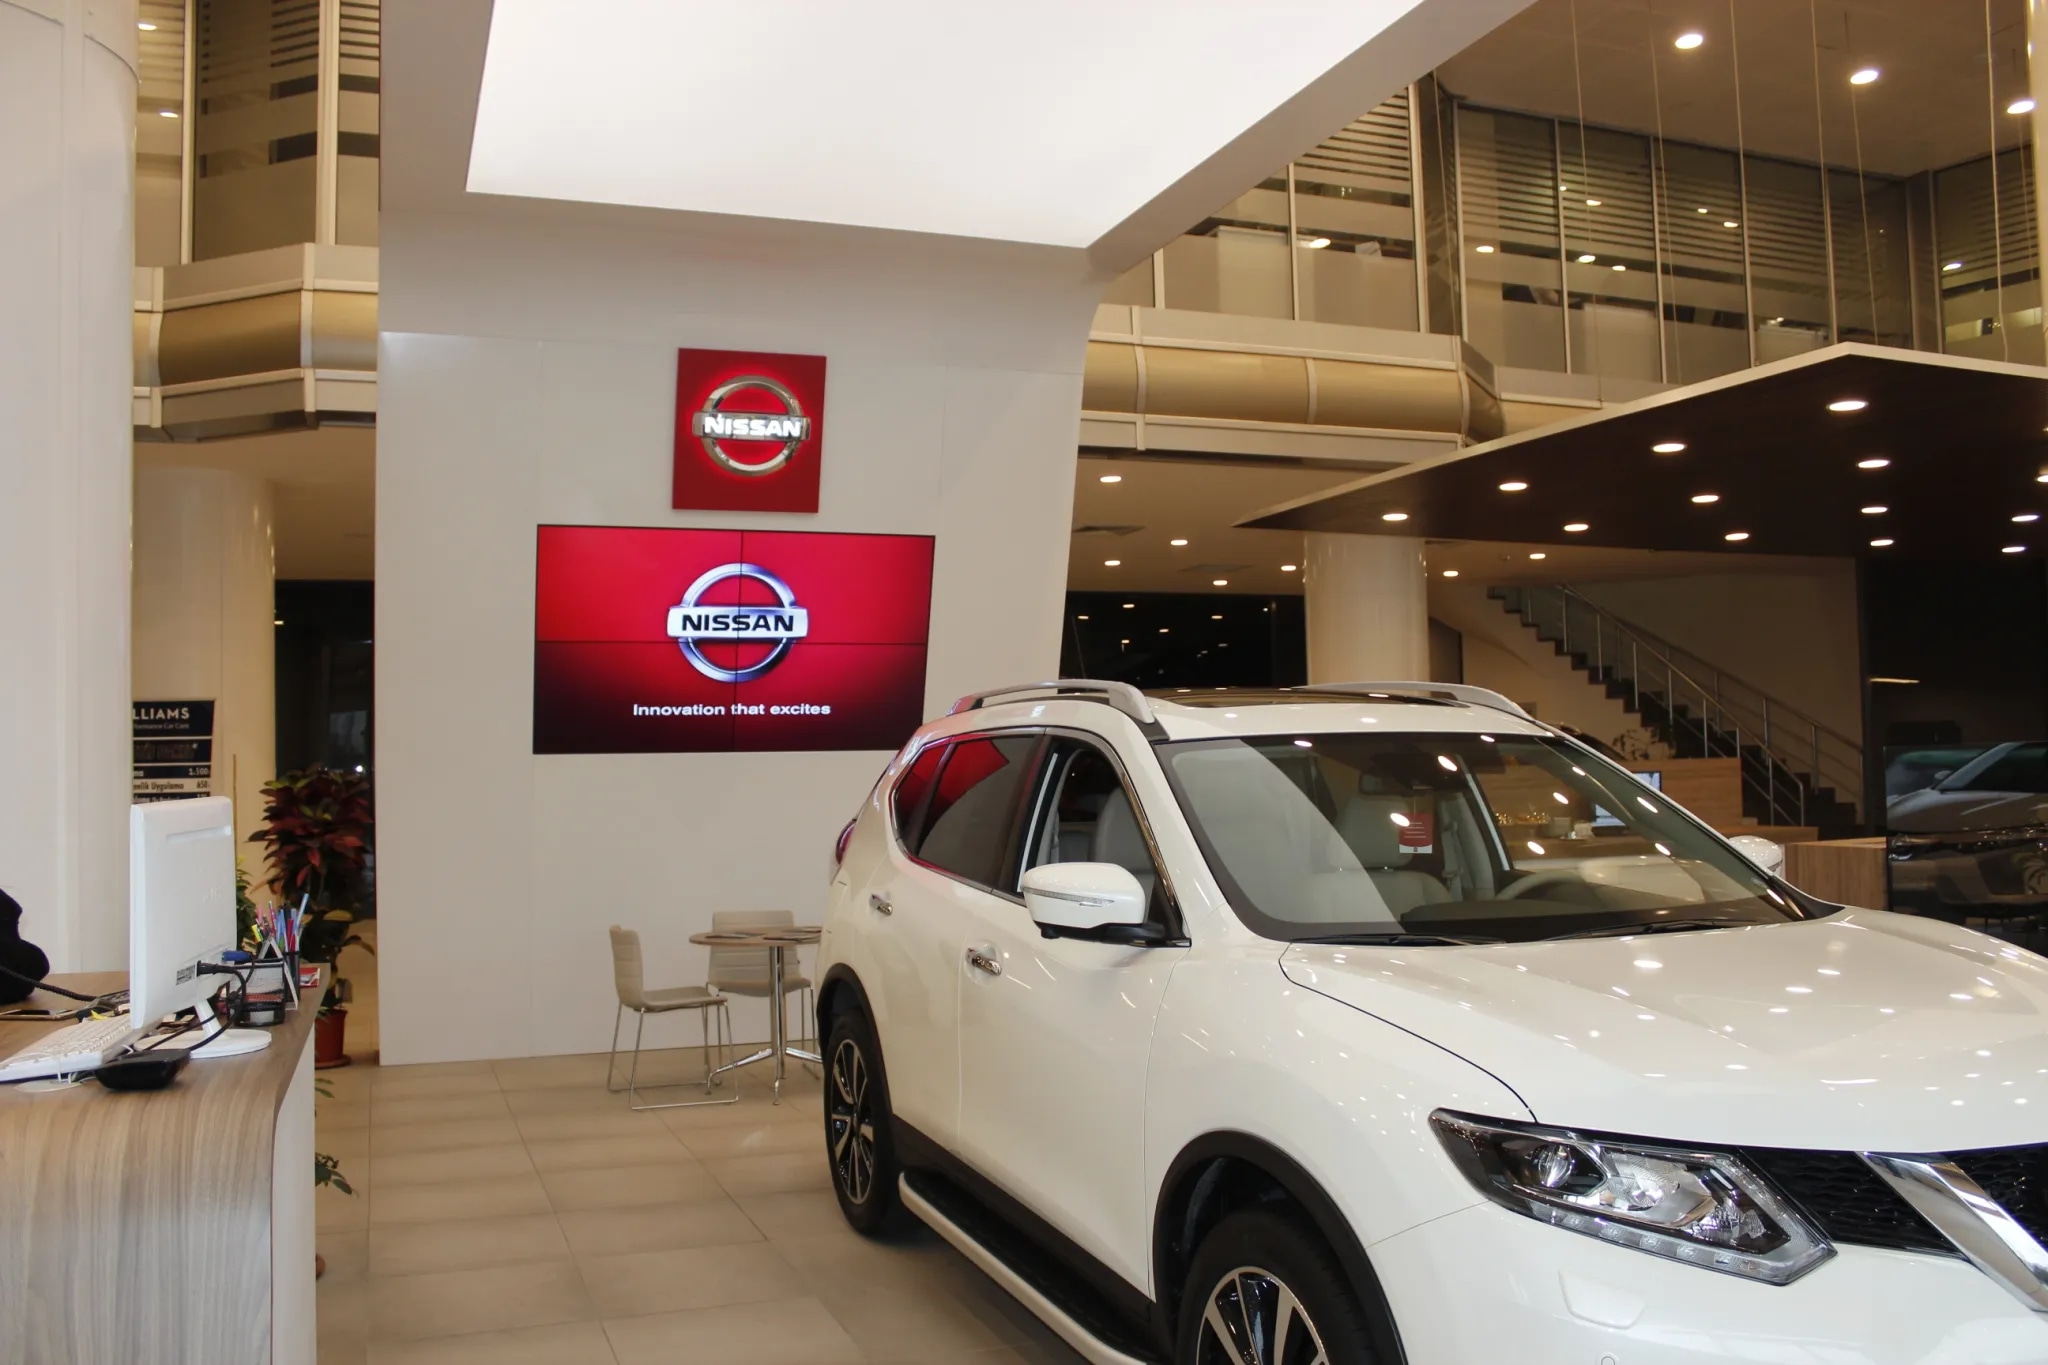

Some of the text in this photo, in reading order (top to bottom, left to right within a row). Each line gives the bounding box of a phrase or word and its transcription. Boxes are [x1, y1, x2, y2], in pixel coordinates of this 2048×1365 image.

[704, 415, 801, 437] NISSAN
[682, 614, 794, 632] NISSAN
[633, 703, 831, 716] Innovation that excites
